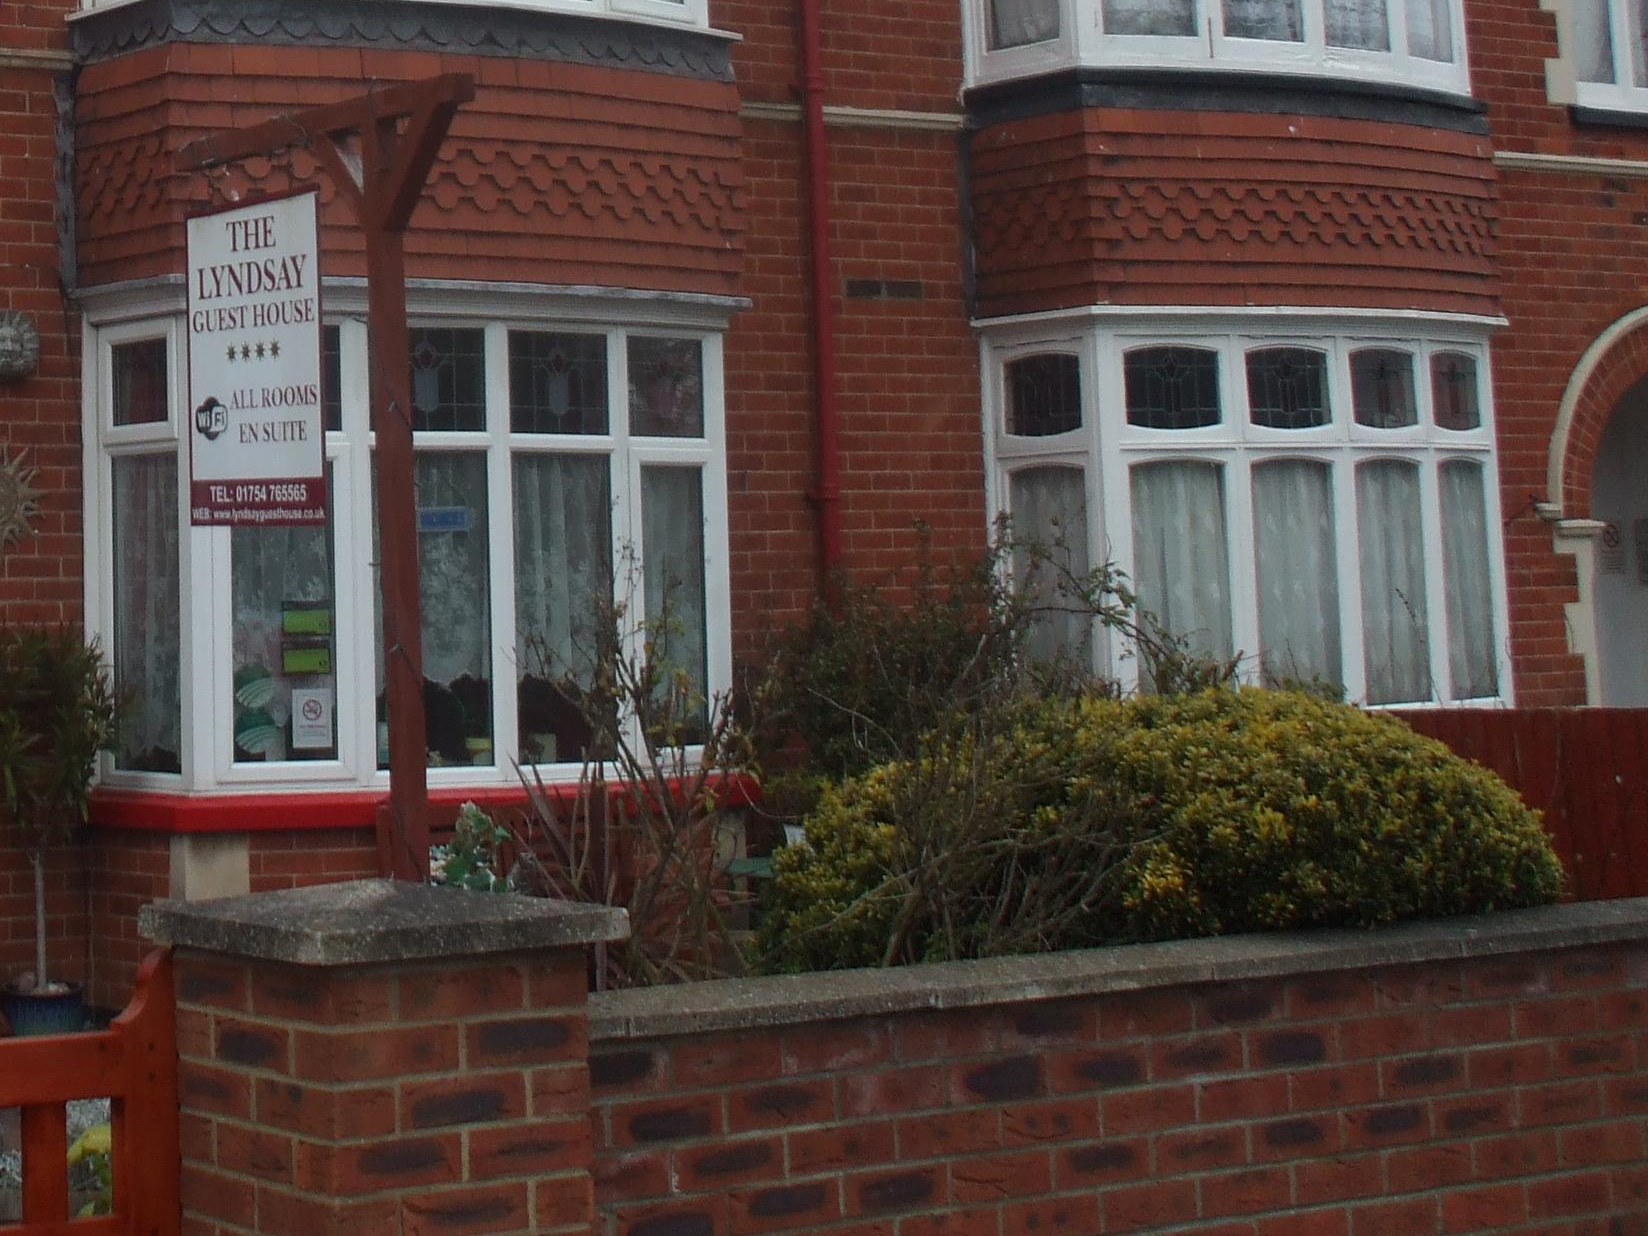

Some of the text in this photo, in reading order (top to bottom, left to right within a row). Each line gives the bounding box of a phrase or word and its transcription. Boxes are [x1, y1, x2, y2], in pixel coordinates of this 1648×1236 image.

[225, 215, 276, 252] THE
[197, 254, 307, 300] LYNDSAY
[192, 298, 315, 334] GUEST HOUSE
[230, 384, 318, 410] ALL ROOMS
[239, 420, 307, 444] EN SUITE
[210, 484, 307, 502] TEL: 01754 765565
